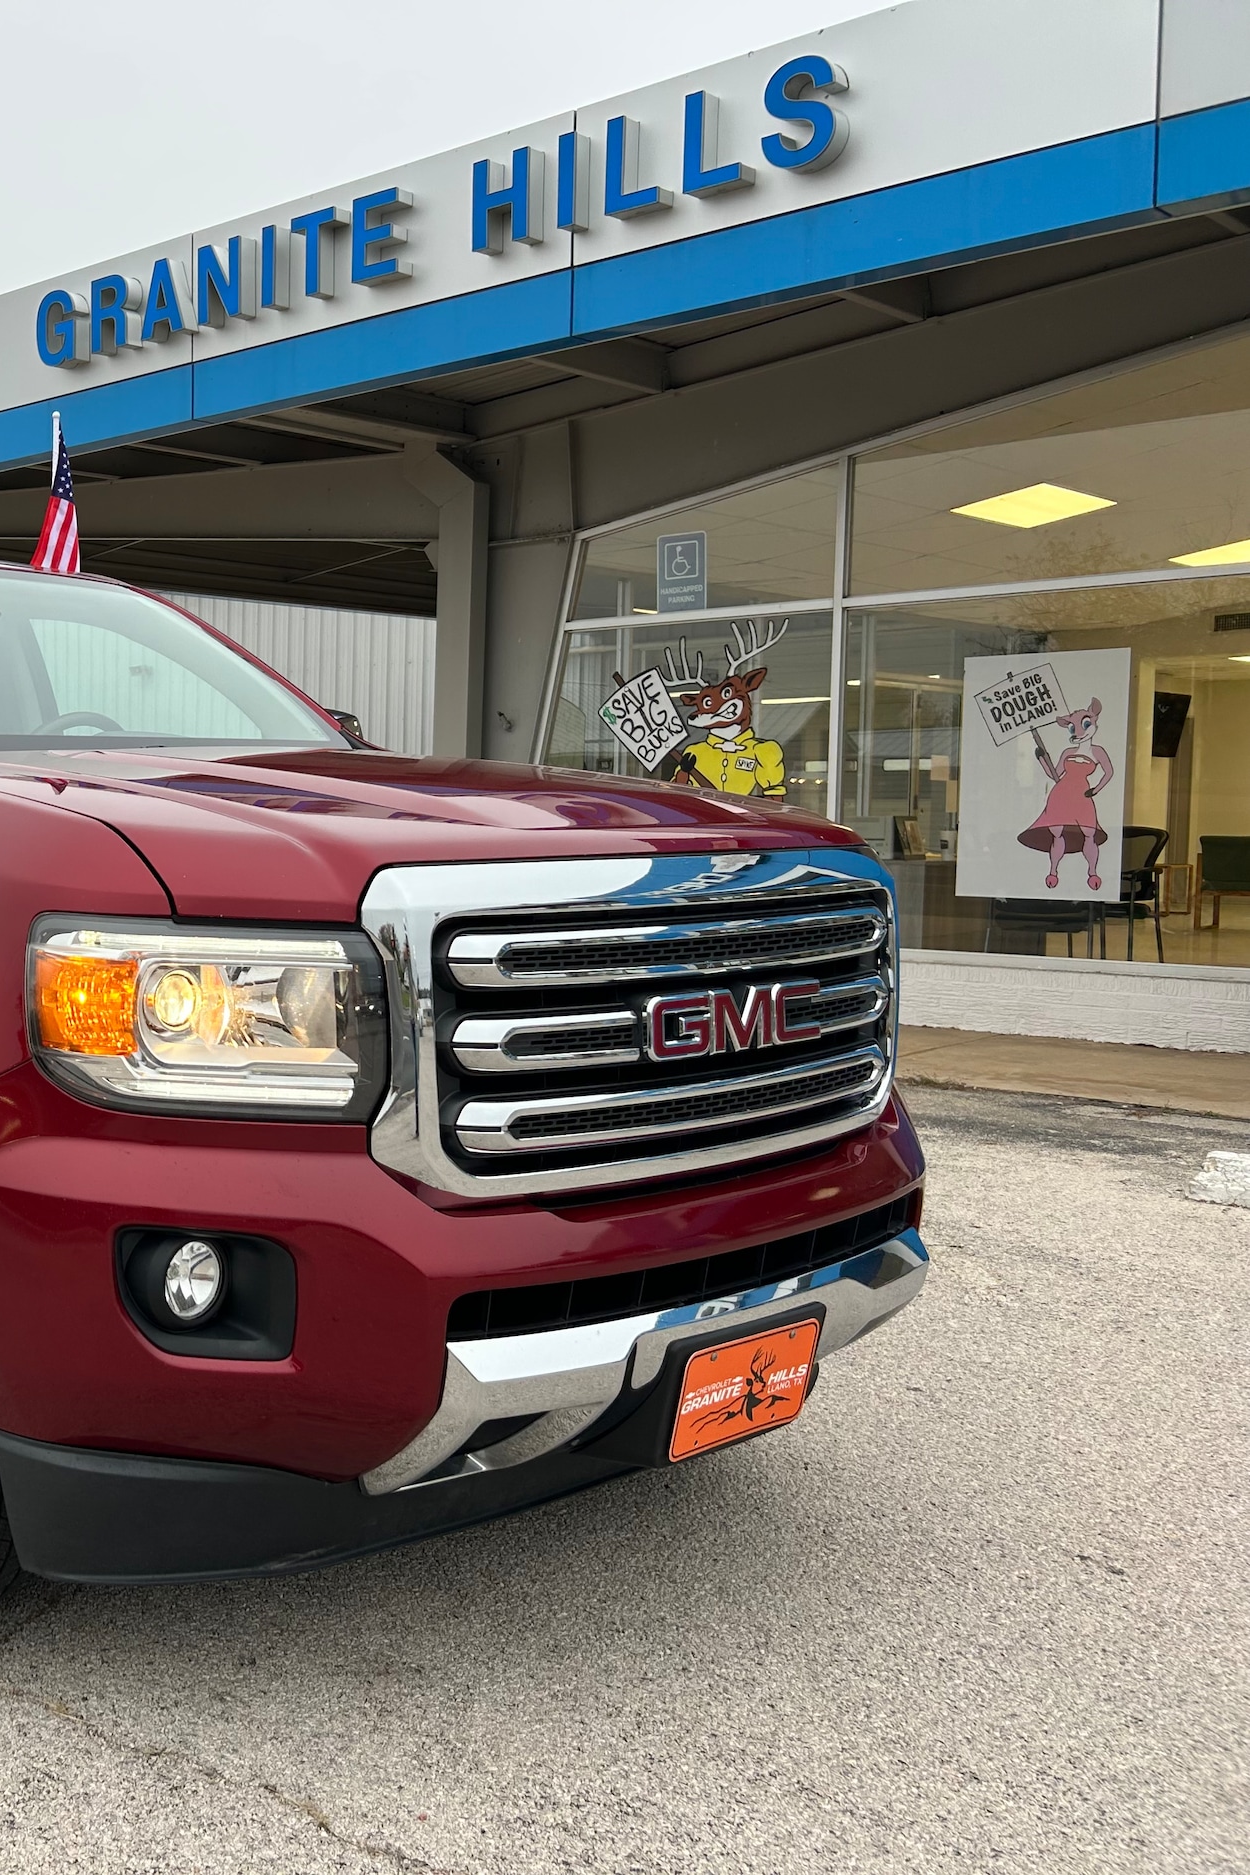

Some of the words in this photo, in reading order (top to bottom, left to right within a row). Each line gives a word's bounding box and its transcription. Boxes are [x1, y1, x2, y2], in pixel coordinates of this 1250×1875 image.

[35, 187, 413, 369] GRANITE
[471, 55, 850, 255] HILLS
[660, 584, 703, 595] HANDICAPPED
[668, 595, 695, 604] PARKING
[612, 674, 661, 719] SAVE
[990, 683, 1052, 723] DOUGH
[994, 685, 1021, 702] Save
[1022, 673, 1042, 689] BIG
[620, 699, 667, 744] BIG
[999, 722, 1012, 733] in
[1012, 700, 1057, 727] LLANO!
[637, 716, 684, 763] BUCKS
[646, 978, 821, 1062] GMC
[681, 1383, 744, 1415] GRANITE
[767, 1363, 809, 1385] HILLS
[695, 1378, 732, 1396] CHEVROLET
[793, 1378, 804, 1386] TX
